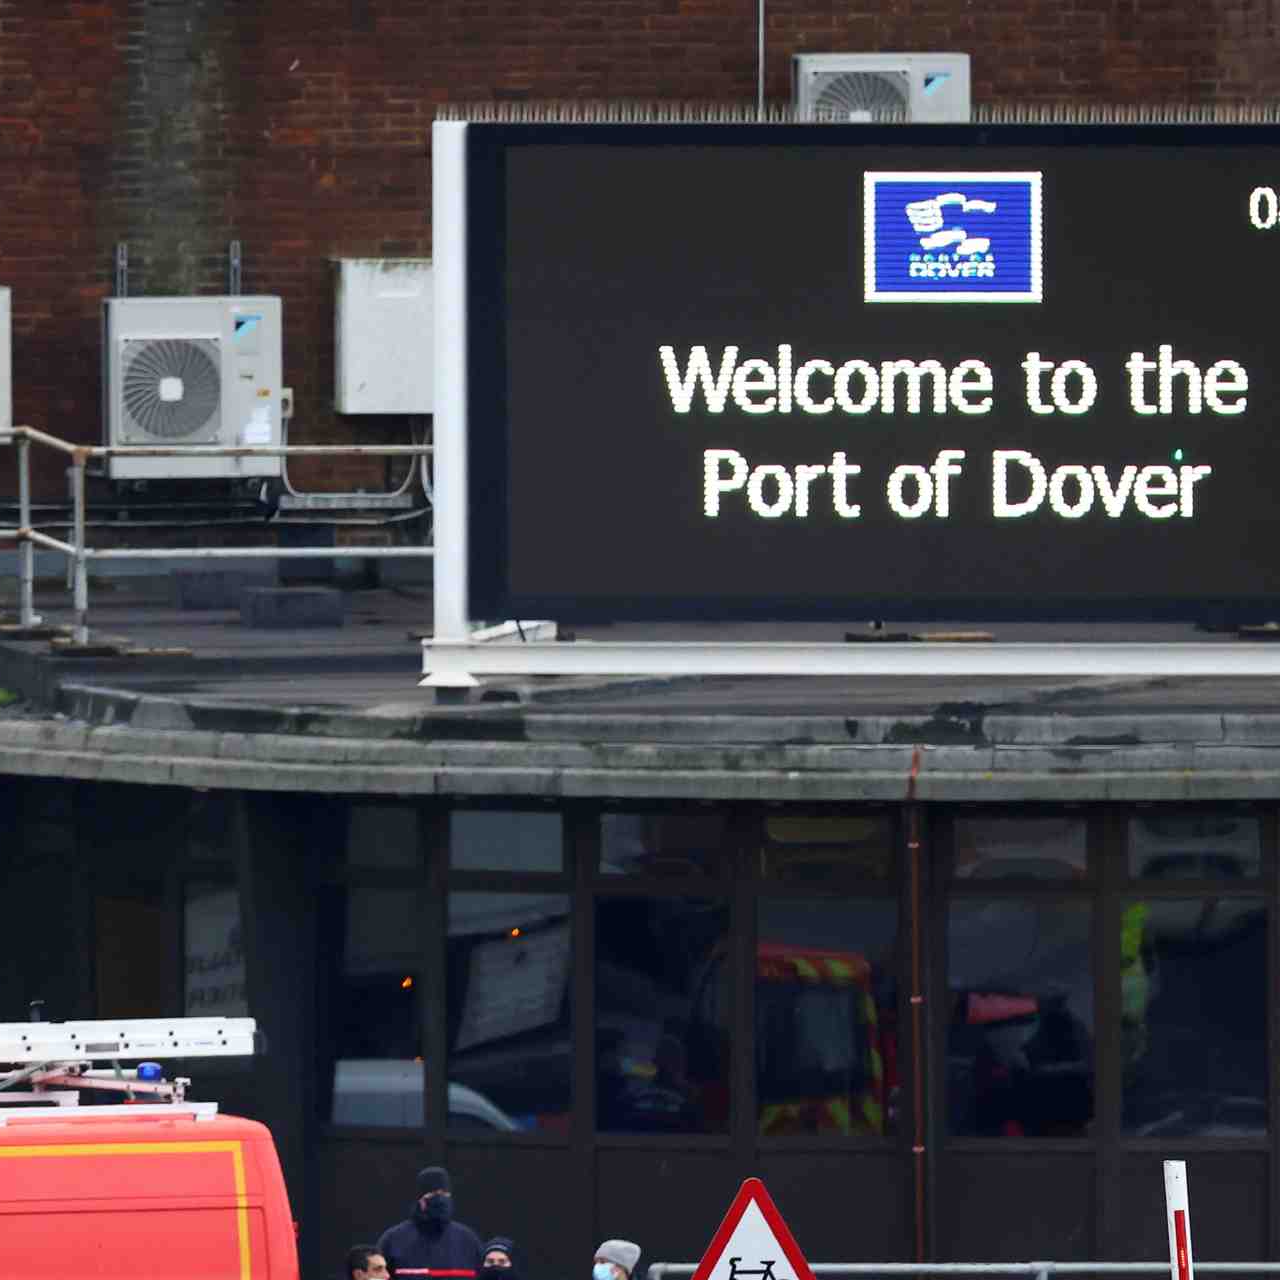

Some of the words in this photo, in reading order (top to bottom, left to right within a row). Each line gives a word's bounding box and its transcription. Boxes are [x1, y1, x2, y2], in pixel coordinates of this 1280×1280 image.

[658, 343, 994, 415] Welcome
[1020, 353, 1098, 415] to
[1124, 343, 1249, 415] the
[703, 449, 862, 519] Port
[886, 449, 966, 519] of
[992, 449, 1212, 519] Dover
